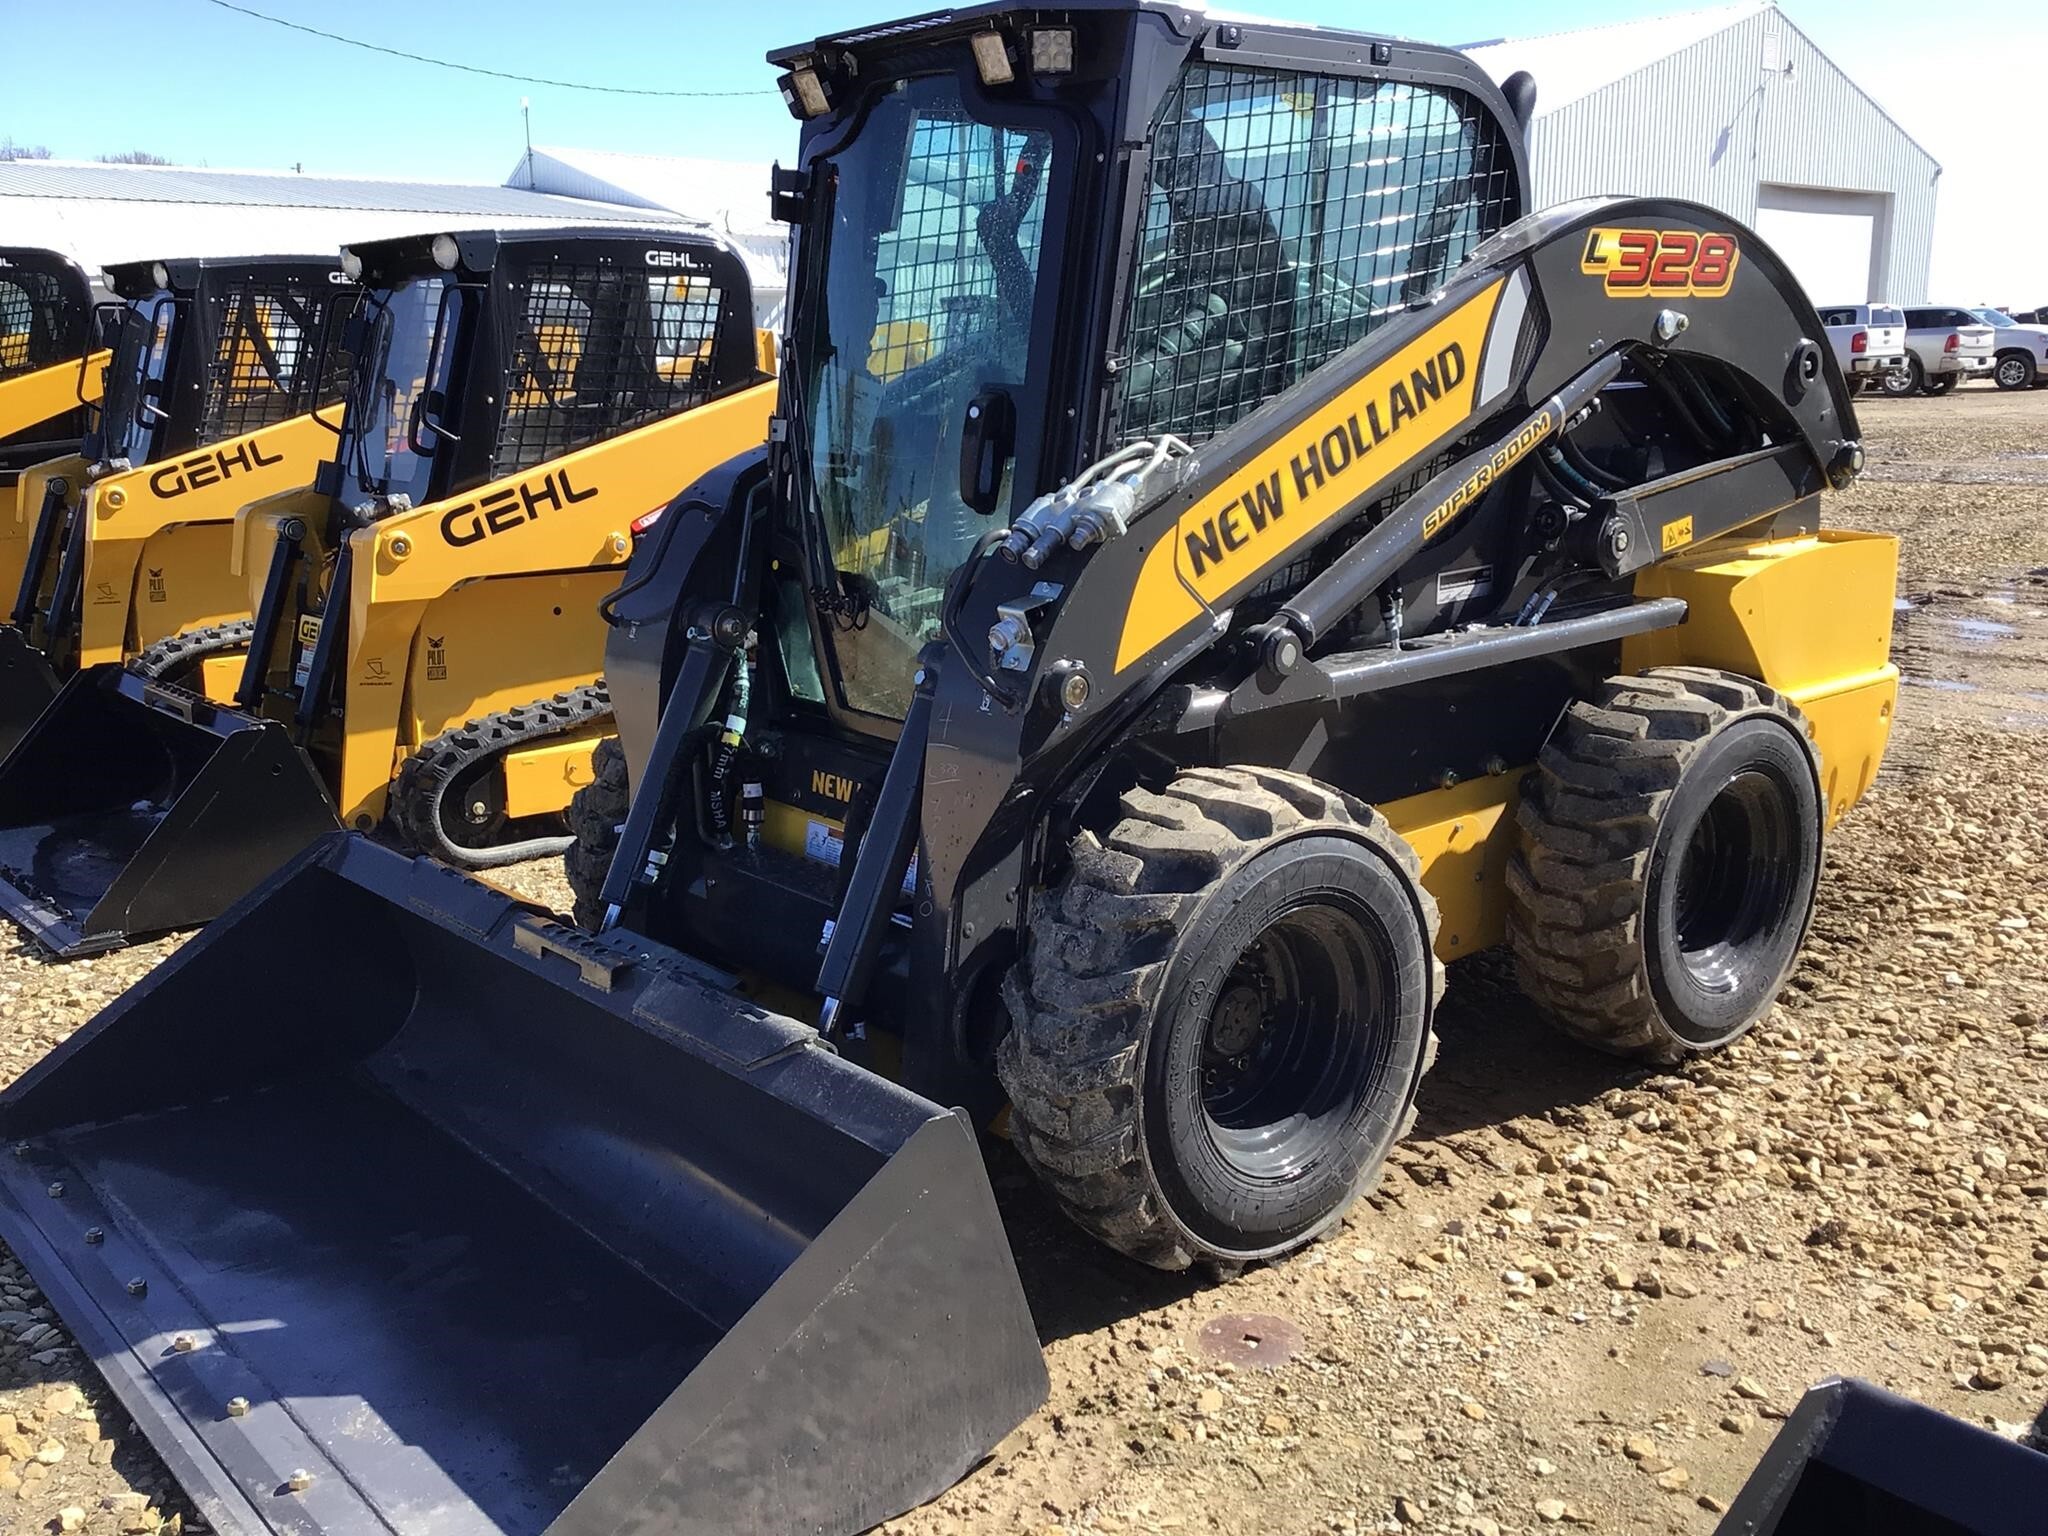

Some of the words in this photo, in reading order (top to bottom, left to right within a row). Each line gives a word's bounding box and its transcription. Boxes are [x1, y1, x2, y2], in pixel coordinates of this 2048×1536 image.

[328, 271, 354, 285] GE
[645, 250, 698, 268] GEHL
[1581, 228, 1739, 298] L328
[149, 439, 284, 499] GEHL
[1183, 470, 1286, 578] NEW
[1290, 341, 1467, 502] HOLLAND
[1422, 466, 1492, 539] SUPER
[1491, 411, 1552, 480] BOOM
[440, 468, 599, 548] GEHL
[301, 620, 321, 639] GE
[427, 649, 446, 666] PILOT
[812, 770, 854, 803] NEW
